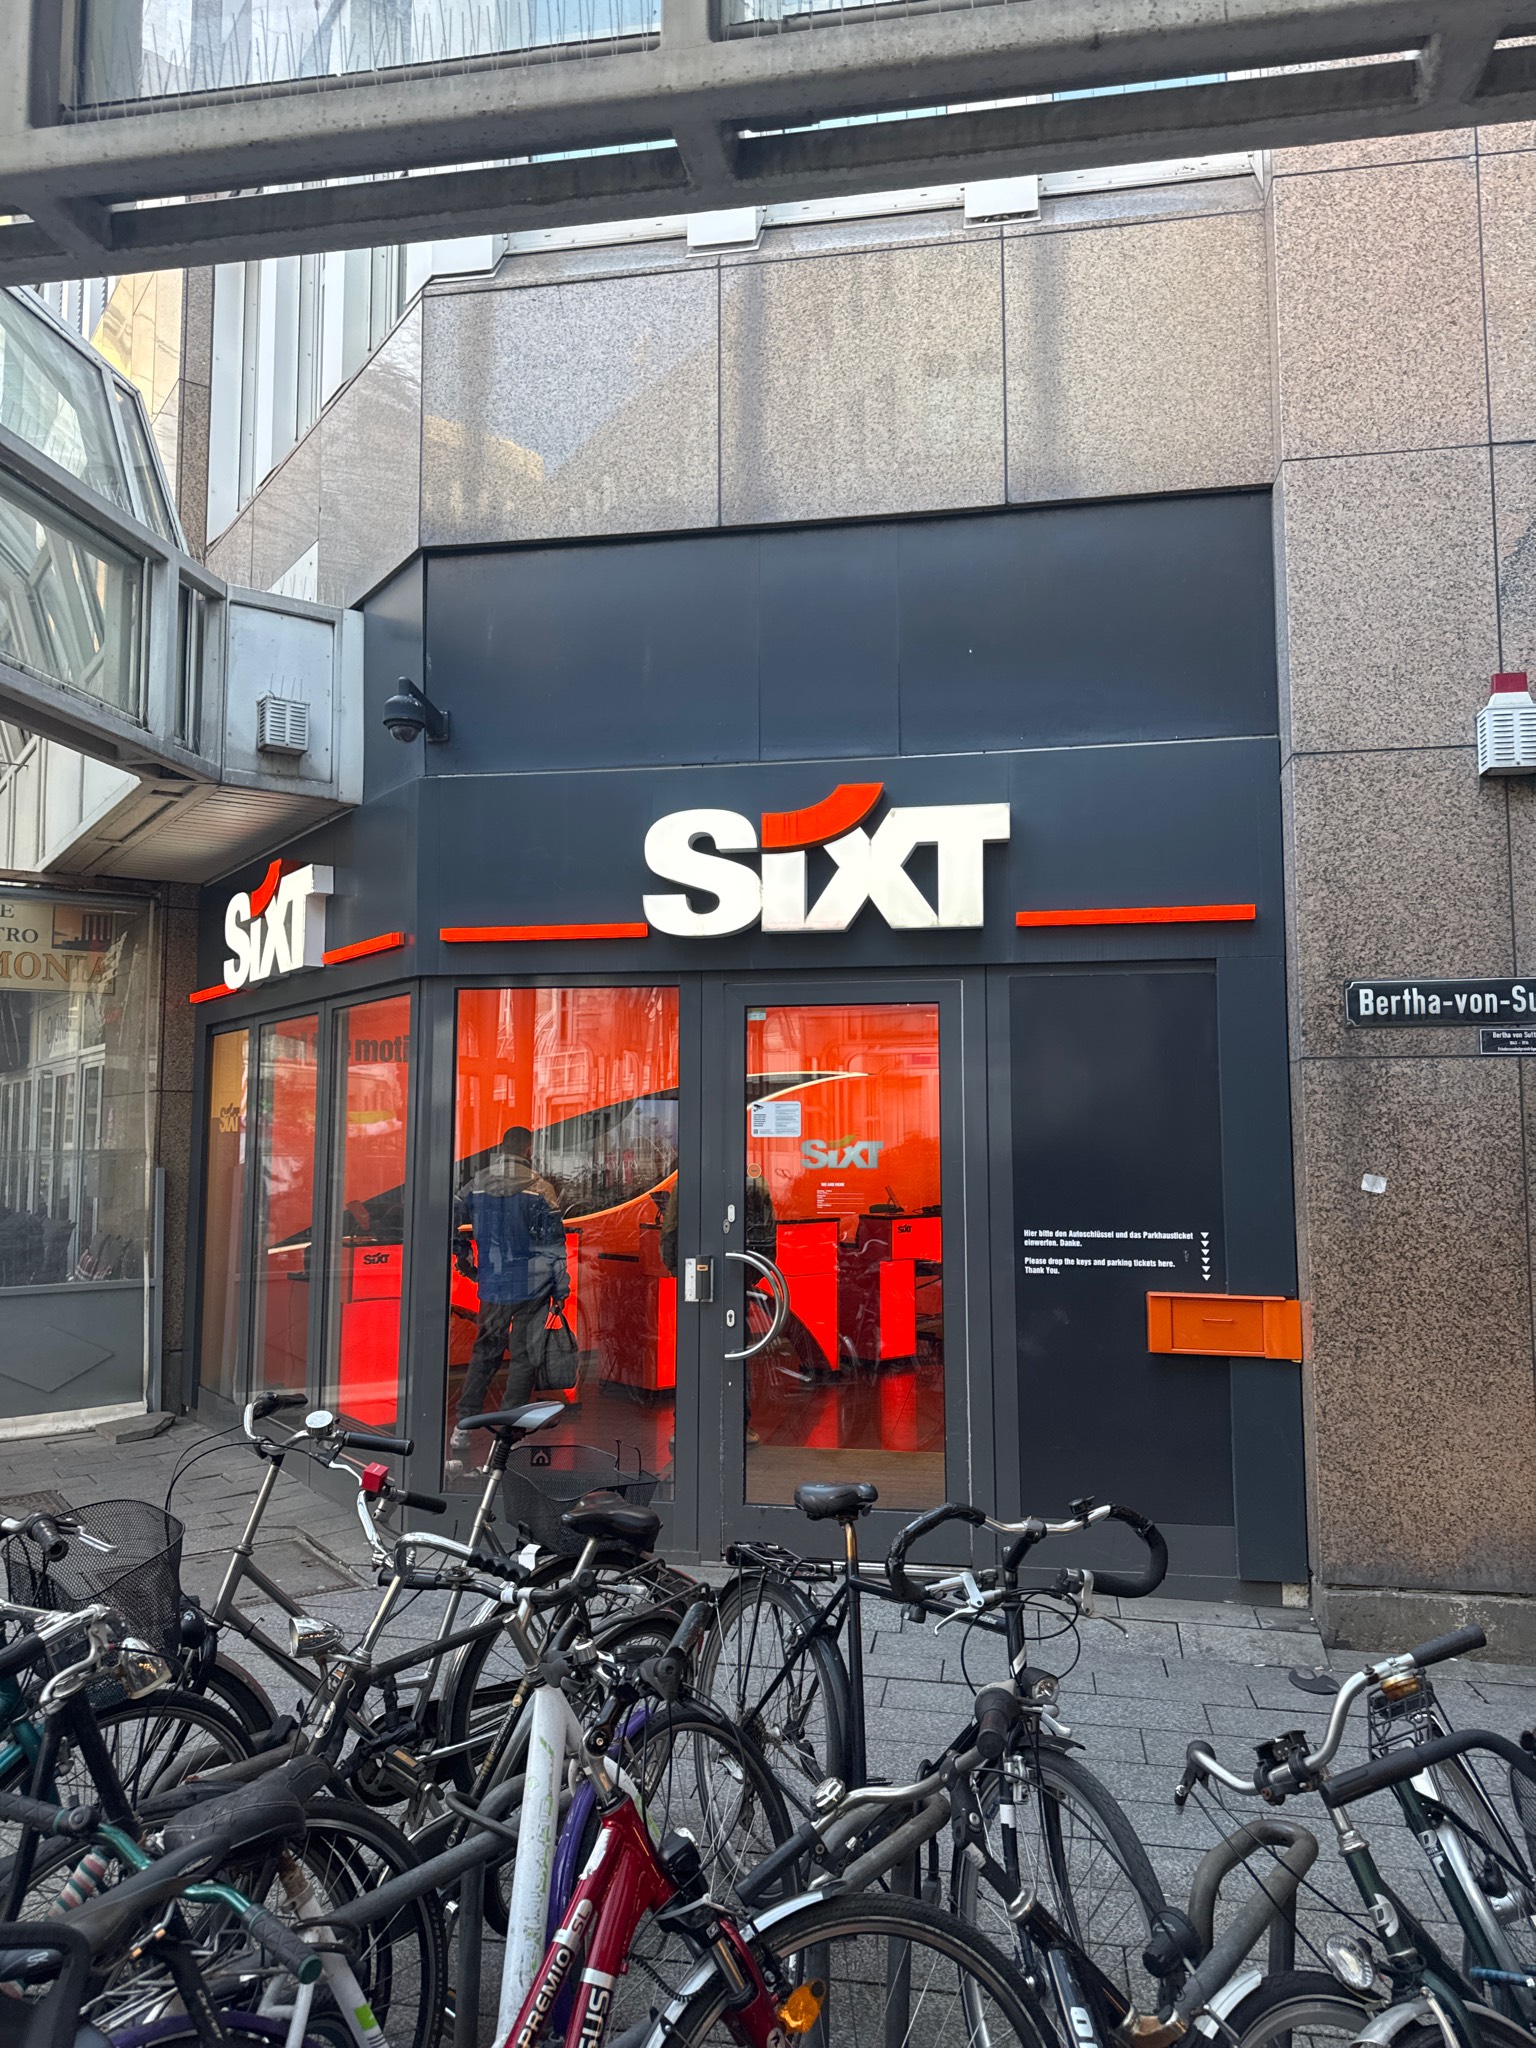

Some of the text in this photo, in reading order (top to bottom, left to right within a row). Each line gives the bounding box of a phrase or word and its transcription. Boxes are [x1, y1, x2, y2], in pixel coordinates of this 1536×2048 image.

[1023, 1229, 1037, 1237] Hier
[1038, 1229, 1054, 1237] bitte
[1054, 1230, 1067, 1238] den
[1068, 1230, 1114, 1238] Autoschlüssel
[1129, 1231, 1141, 1239] das
[1143, 1231, 1194, 1239] Parkhausticket
[1023, 1239, 1083, 1247] einwerfen. Danke.
[1024, 1257, 1047, 1265] Please
[1048, 1257, 1063, 1266] drop
[1076, 1258, 1092, 1267] keys
[1093, 1258, 1106, 1266] and
[1106, 1258, 1132, 1267] parking
[1133, 1259, 1157, 1267] tickets
[1157, 1260, 1176, 1268] here.
[1024, 1266, 1060, 1275] Thank You.
[571, 1908, 592, 1936] SL
[516, 1946, 573, 2048] PREMIO
